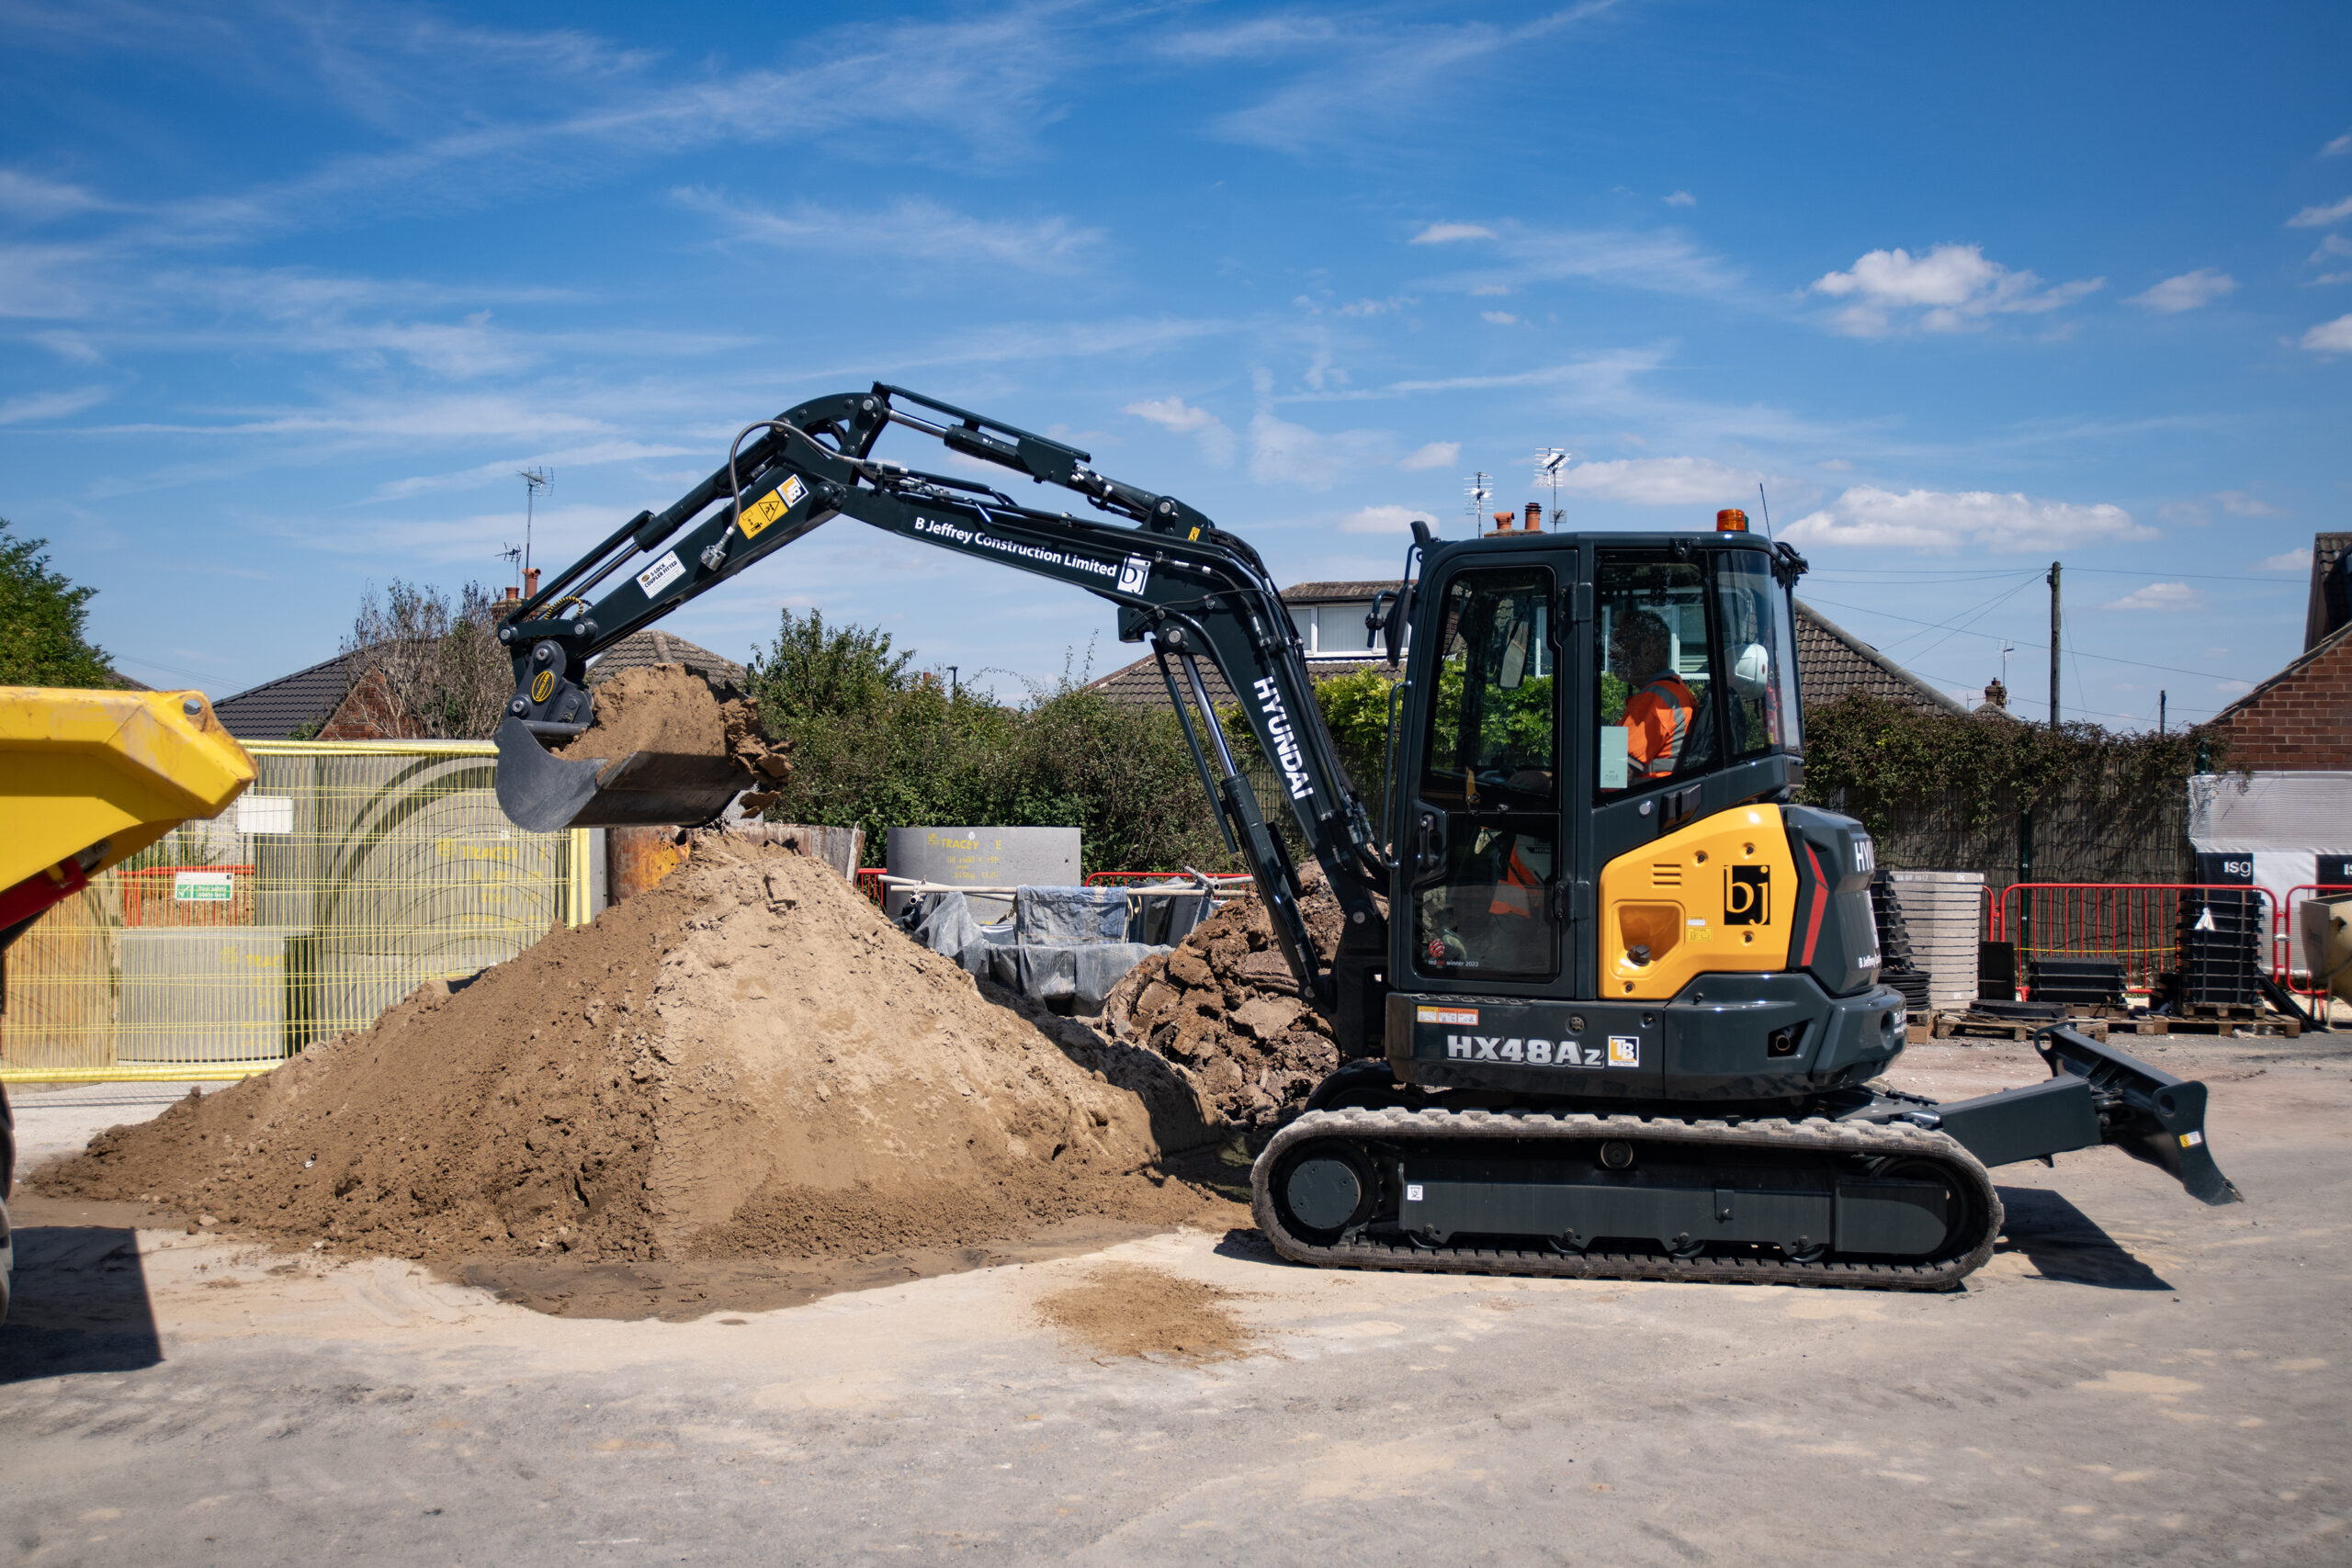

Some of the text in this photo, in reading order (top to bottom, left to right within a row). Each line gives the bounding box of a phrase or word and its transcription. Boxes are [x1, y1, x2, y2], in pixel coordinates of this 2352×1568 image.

[914, 516, 1118, 577] B Jeffrey Construction Limited
[662, 559, 678, 574] FITTED
[1253, 676, 1315, 800] HYUNDAI
[461, 845, 519, 860] TRACEY
[941, 838, 979, 850] TRACEY
[1612, 1039, 1634, 1059] TB
